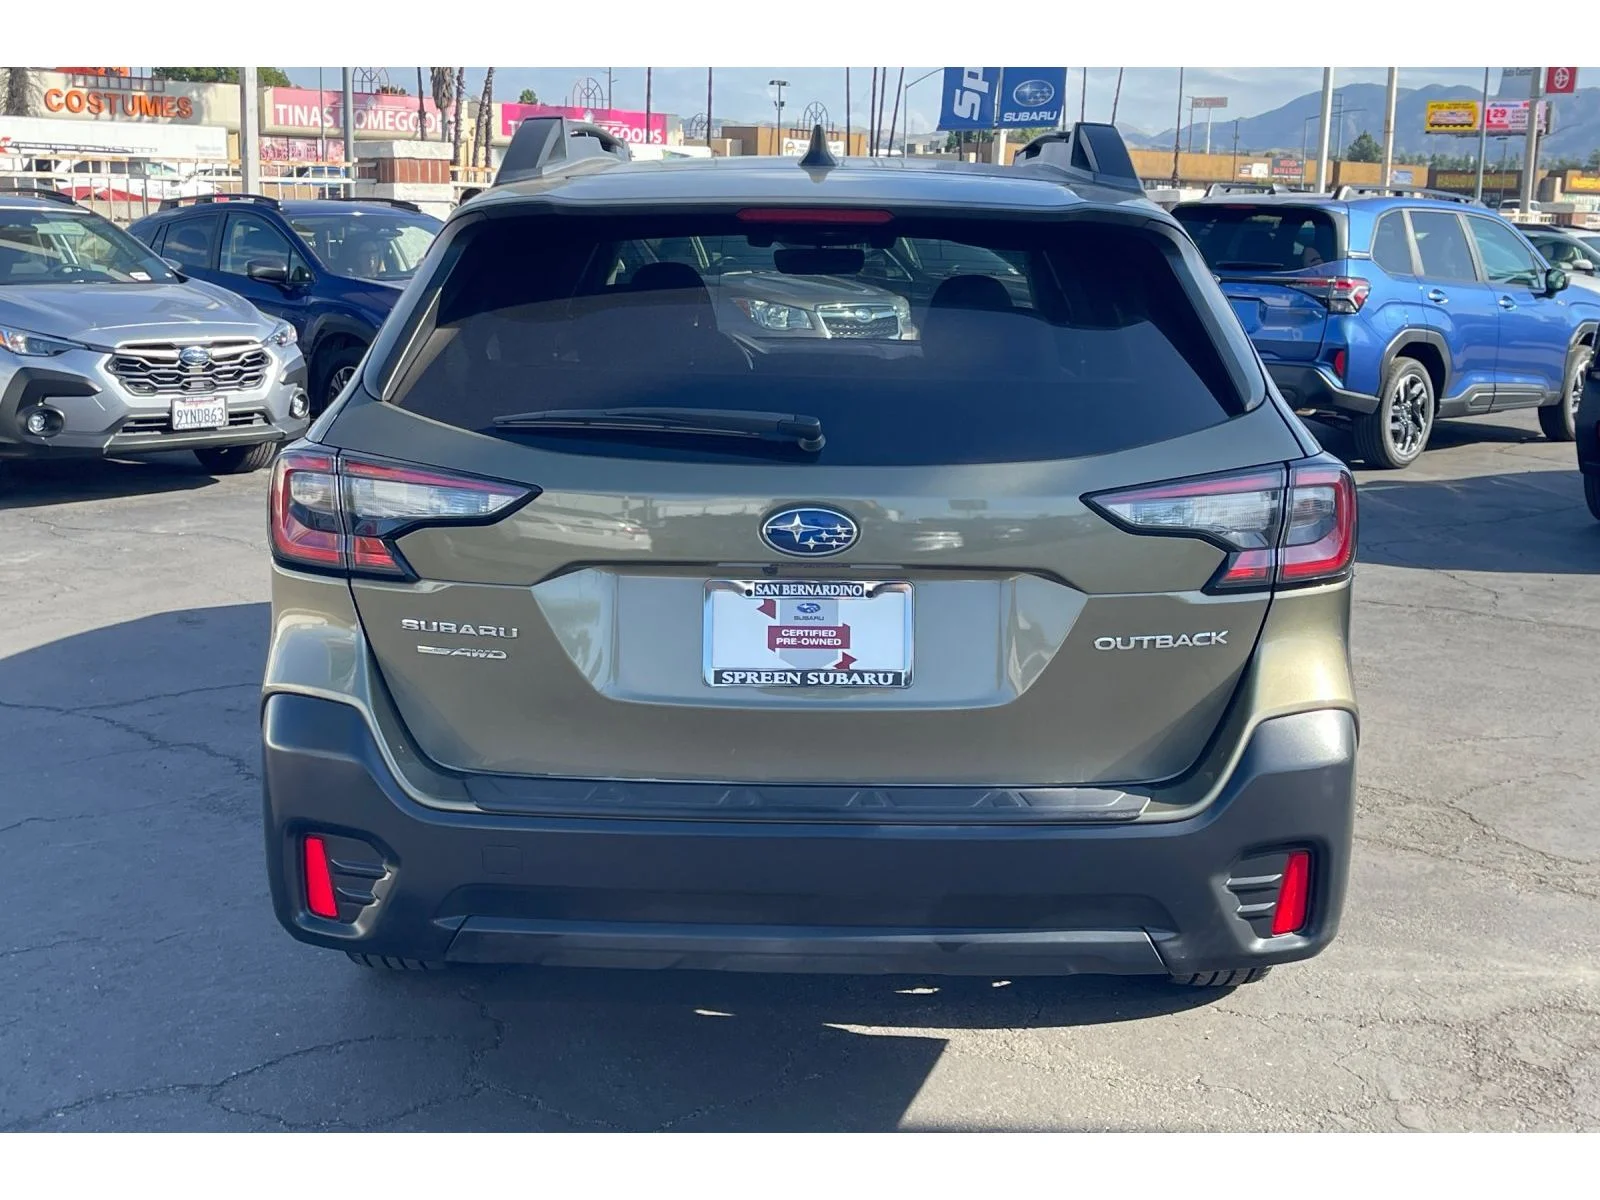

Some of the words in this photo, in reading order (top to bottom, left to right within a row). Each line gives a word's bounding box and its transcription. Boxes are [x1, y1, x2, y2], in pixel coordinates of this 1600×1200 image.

[44, 88, 193, 119] COSTUMES
[275, 104, 335, 128] TINAS
[1003, 110, 1057, 122] SUBARU
[176, 407, 224, 424] 9YND863
[756, 584, 780, 596] SAN
[783, 583, 863, 597] BERNARDINO
[401, 618, 518, 638] SUBARU
[781, 629, 837, 637] CERTIFIED
[776, 638, 842, 646] PRE-OWNED
[1094, 630, 1229, 650] OUTBACK
[450, 647, 508, 659] AWD
[721, 671, 801, 685] SPREEN
[807, 671, 895, 685] SUBARU
